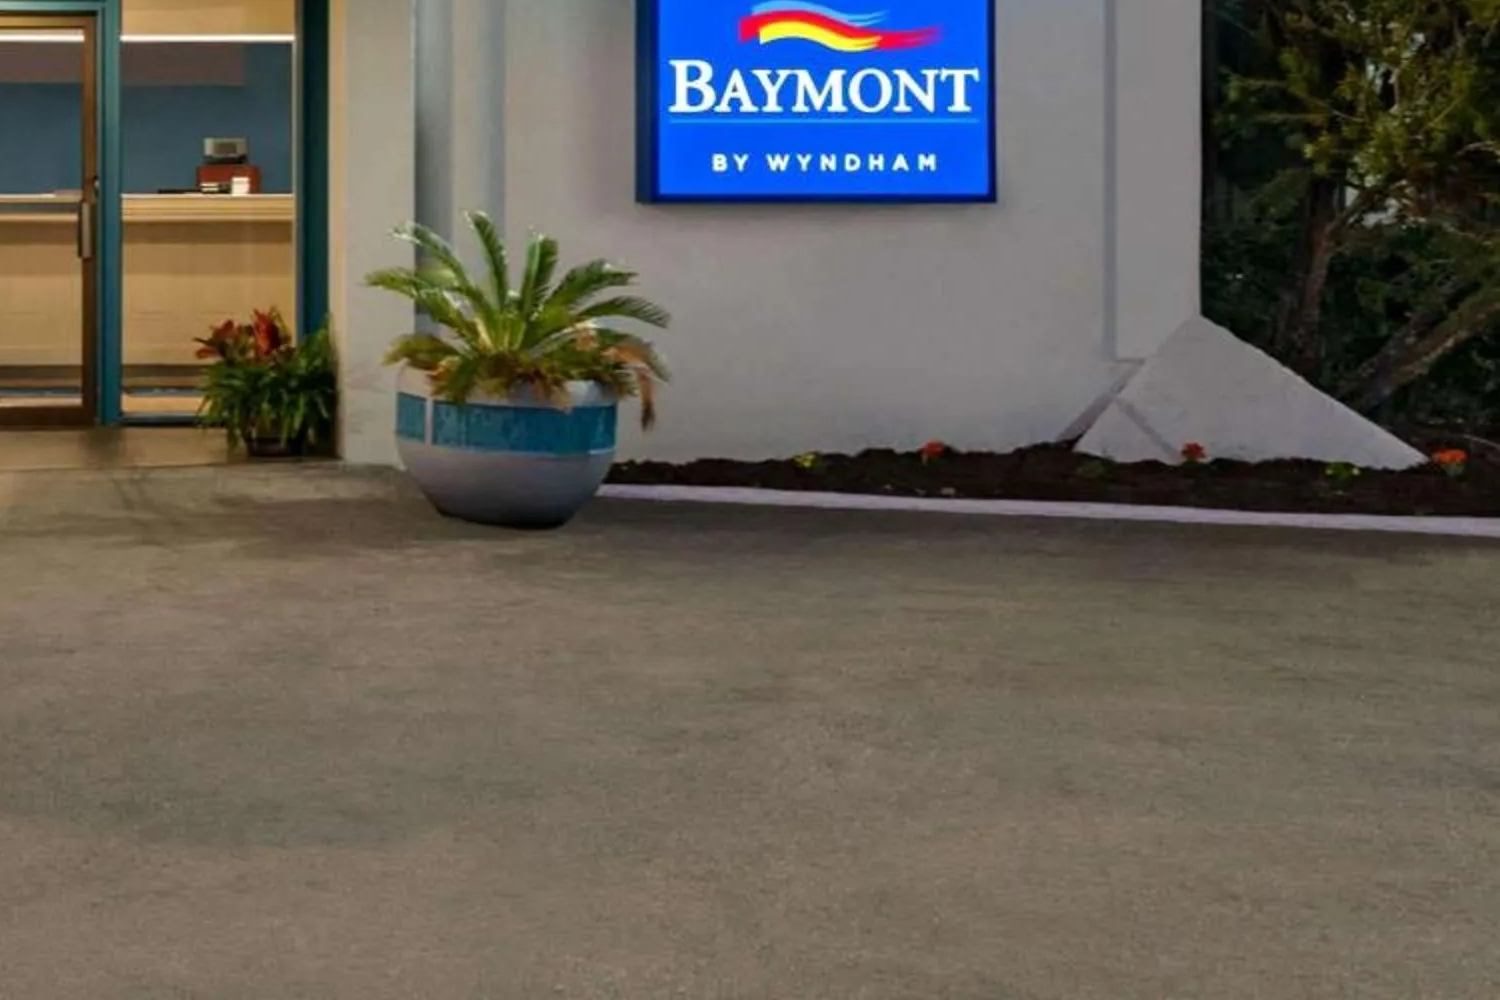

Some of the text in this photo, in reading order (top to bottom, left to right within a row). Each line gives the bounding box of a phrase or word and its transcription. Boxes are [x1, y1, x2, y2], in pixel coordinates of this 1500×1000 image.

[668, 59, 980, 113] BAYMONT
[712, 153, 938, 172] BY WYNDHAM
